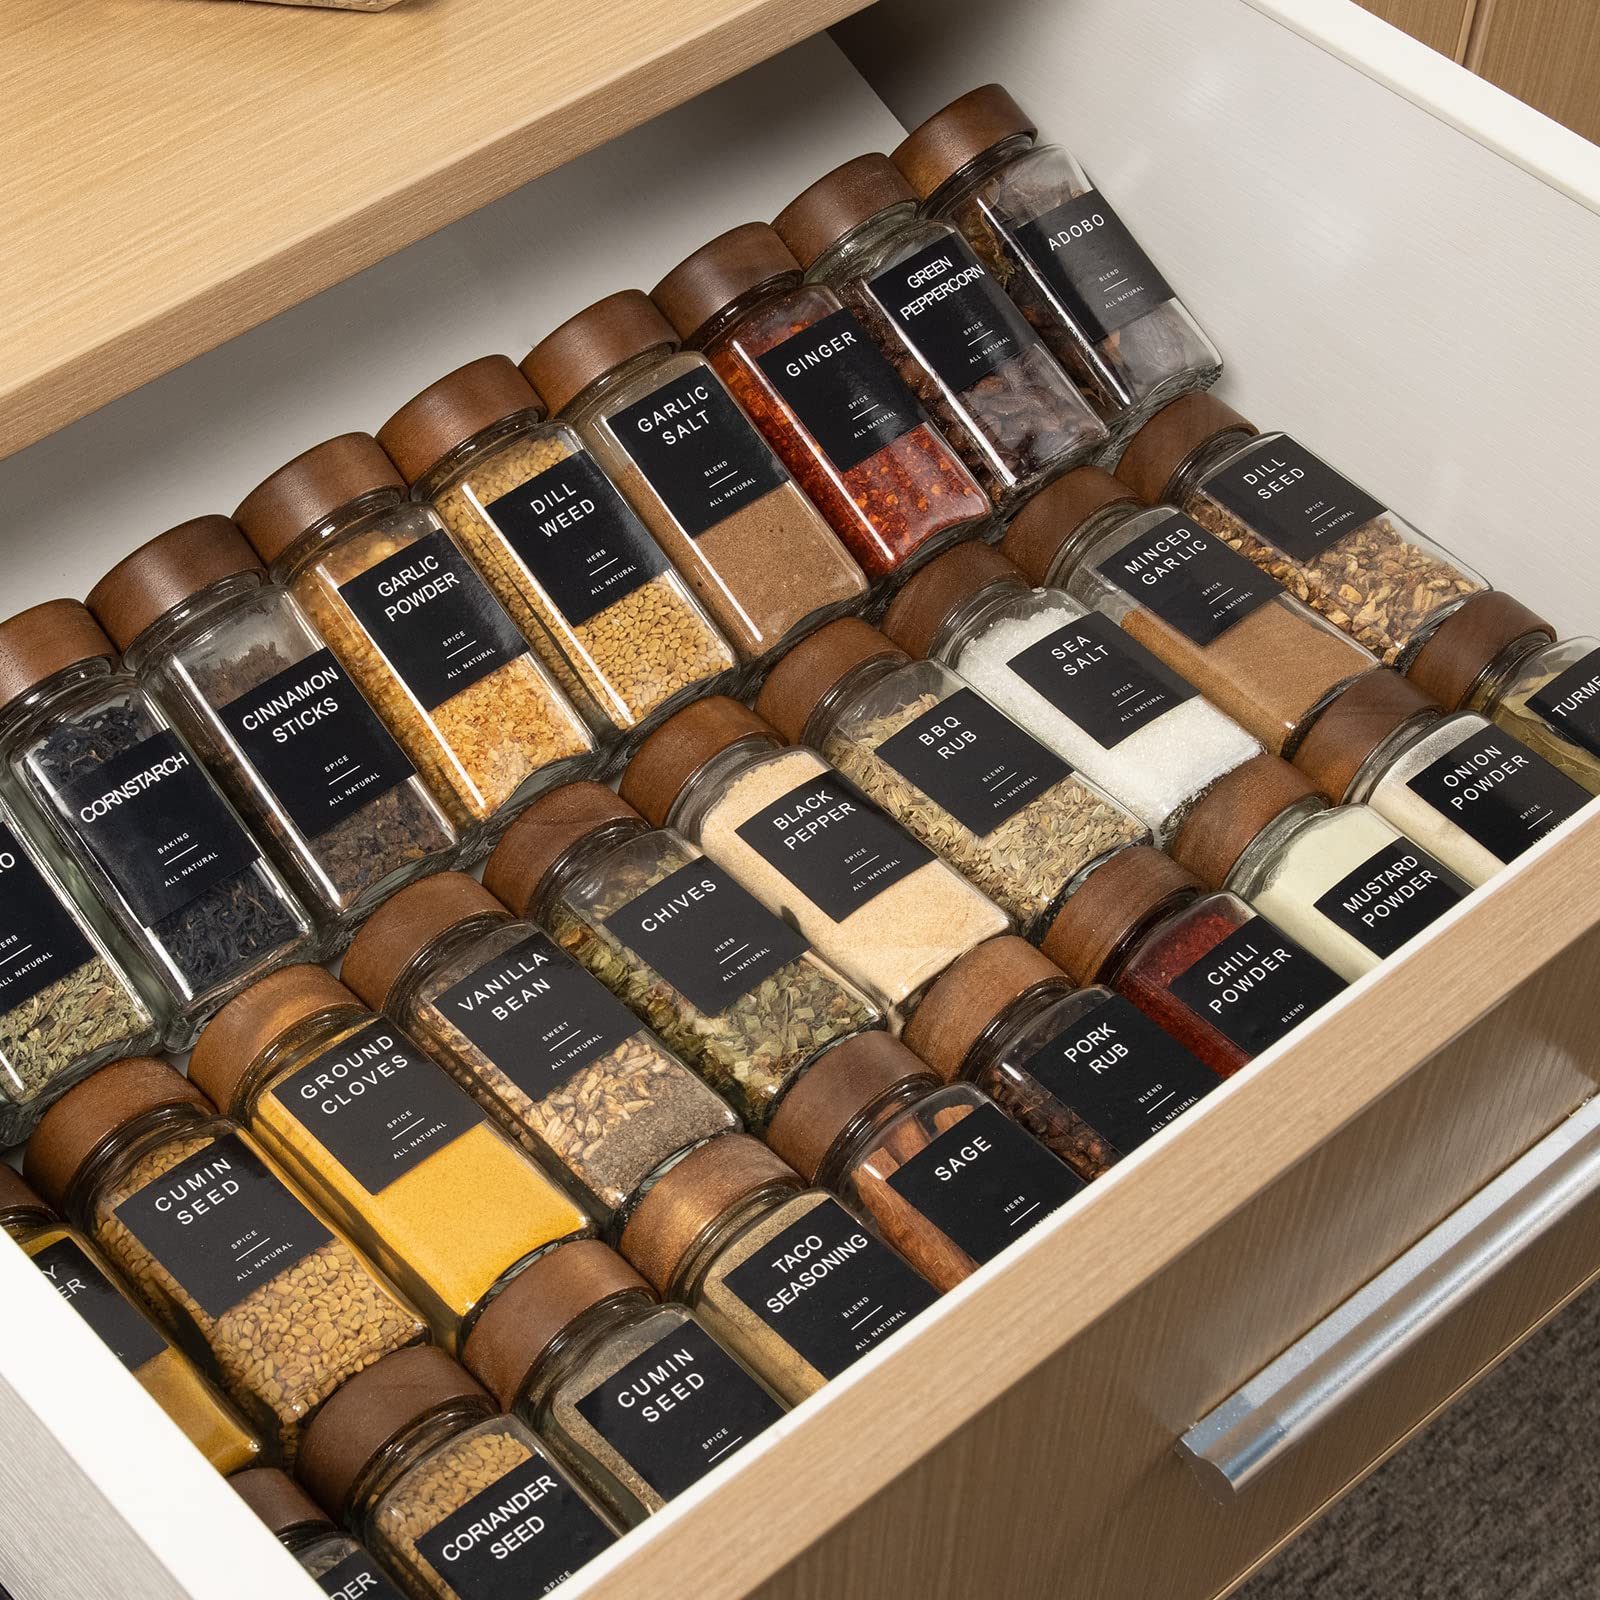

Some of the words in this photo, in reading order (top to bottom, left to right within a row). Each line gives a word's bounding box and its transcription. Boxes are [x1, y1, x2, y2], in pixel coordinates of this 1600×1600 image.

[1047, 214, 1105, 251] ADOBO
[907, 256, 953, 289] GREEN
[1099, 269, 1119, 281] BLEND
[900, 264, 985, 321] PEPPERCORN
[1105, 299, 1117, 309] ALL
[1118, 285, 1144, 302] NATURAL
[963, 321, 983, 335] SPICE
[786, 331, 857, 377] GINGER
[969, 354, 982, 364] ALL
[983, 336, 1010, 356] NATURAL
[637, 386, 710, 433] GARLIC
[848, 395, 868, 409] SPICE
[662, 410, 710, 445] SALT
[853, 428, 866, 438] ALL
[868, 411, 896, 430] NATURAL
[704, 460, 728, 477] BLEND
[1243, 459, 1286, 484] DILL
[1257, 468, 1305, 500] SEED
[531, 483, 576, 515] DILL
[710, 497, 723, 507] ALL
[725, 477, 756, 499] NATURAL
[1305, 501, 1324, 514] SPICE
[539, 500, 595, 538] WEED
[1315, 526, 1327, 536] ALL
[1327, 510, 1354, 529] NATURAL
[586, 549, 606, 563] HERB
[1124, 528, 1191, 574] MINCED
[377, 555, 439, 597] GARLIC
[590, 584, 604, 595] ALL
[605, 564, 637, 586] NATURAL
[1202, 582, 1222, 596] SPICE
[384, 572, 460, 621] POWDER
[1213, 609, 1225, 619] ALL
[1227, 591, 1253, 611] NATURAL
[443, 631, 465, 647] SPICE
[1051, 635, 1091, 660] SEA
[447, 668, 461, 679] ALL
[463, 648, 495, 670] NATURAL
[1063, 645, 1109, 676] SALT
[242, 667, 339, 731] CINNAMON
[1111, 683, 1132, 697] SPICE
[272, 697, 338, 744] STICKS
[1120, 712, 1134, 722] ALL
[1135, 694, 1165, 715] NATURAL
[919, 717, 961, 746] BBQ
[937, 731, 977, 759] RUB
[324, 755, 349, 772] SPICE
[982, 766, 1004, 783] BLEND
[1443, 745, 1502, 787] ONION
[80, 752, 189, 823] CORNSTARCH
[329, 796, 343, 806] ALL
[345, 772, 380, 796] NATURAL
[993, 797, 1006, 808] ALL
[1007, 775, 1038, 798] NATURAL
[1450, 755, 1529, 810] POWDER
[773, 790, 833, 831] BLACK
[784, 802, 857, 850] PEPPER
[1520, 804, 1540, 820] SPICE
[158, 833, 189, 854] BAKING
[844, 848, 866, 864] SPICE
[164, 877, 179, 887] ALL
[181, 853, 218, 877] NATURAL
[852, 881, 866, 891] ALL
[867, 860, 900, 882] NATURAL
[1342, 856, 1417, 913] MUSTARD
[641, 880, 717, 932] CHIVES
[1361, 870, 1438, 928] POWDER
[0, 935, 18, 951] ERB
[714, 938, 735, 953] HERB
[15, 952, 53, 977] NATURAL
[722, 971, 736, 981] ALL
[737, 948, 770, 971] NATURAL
[1208, 944, 1258, 986] CHILI
[1208, 948, 1291, 1014] POWDER
[458, 952, 549, 1012] VANILLA
[492, 979, 551, 1021] BEAN
[1282, 1004, 1305, 1023] BLEND
[542, 1022, 569, 1041] SWEET
[1064, 1023, 1116, 1063] PORK
[301, 1036, 393, 1099] GROUND
[551, 1060, 565, 1070] ALL
[567, 1035, 602, 1060] NATURAL
[1089, 1043, 1128, 1075] RUB
[322, 1055, 408, 1114] CLOVES
[1138, 1083, 1163, 1103] BLEND
[387, 1111, 412, 1129] SPICE
[1151, 1120, 1164, 1133] ALL
[1165, 1096, 1198, 1120] NATURAL
[393, 1145, 409, 1159] ALL
[410, 1122, 446, 1147] NATURAL
[934, 1136, 992, 1181] SAGE
[155, 1158, 232, 1212] CUMIN
[177, 1180, 239, 1226] SEED
[1003, 1195, 1025, 1214] HERB
[231, 1230, 257, 1250] SPICE
[772, 1236, 823, 1274] TACO
[236, 1268, 252, 1281] ALL
[254, 1242, 293, 1268] NATURAL
[766, 1233, 868, 1314] SEASONING
[843, 1296, 869, 1319] BLEND
[855, 1338, 870, 1351] ALL
[871, 1309, 906, 1339] NATURAL
[618, 1348, 694, 1409] CUMIN
[642, 1372, 704, 1423] SEED
[702, 1428, 728, 1450] SPICE
[442, 1475, 558, 1562] CORIANDER
[490, 1515, 545, 1560] SEED
[544, 1570, 571, 1593] SPICE
